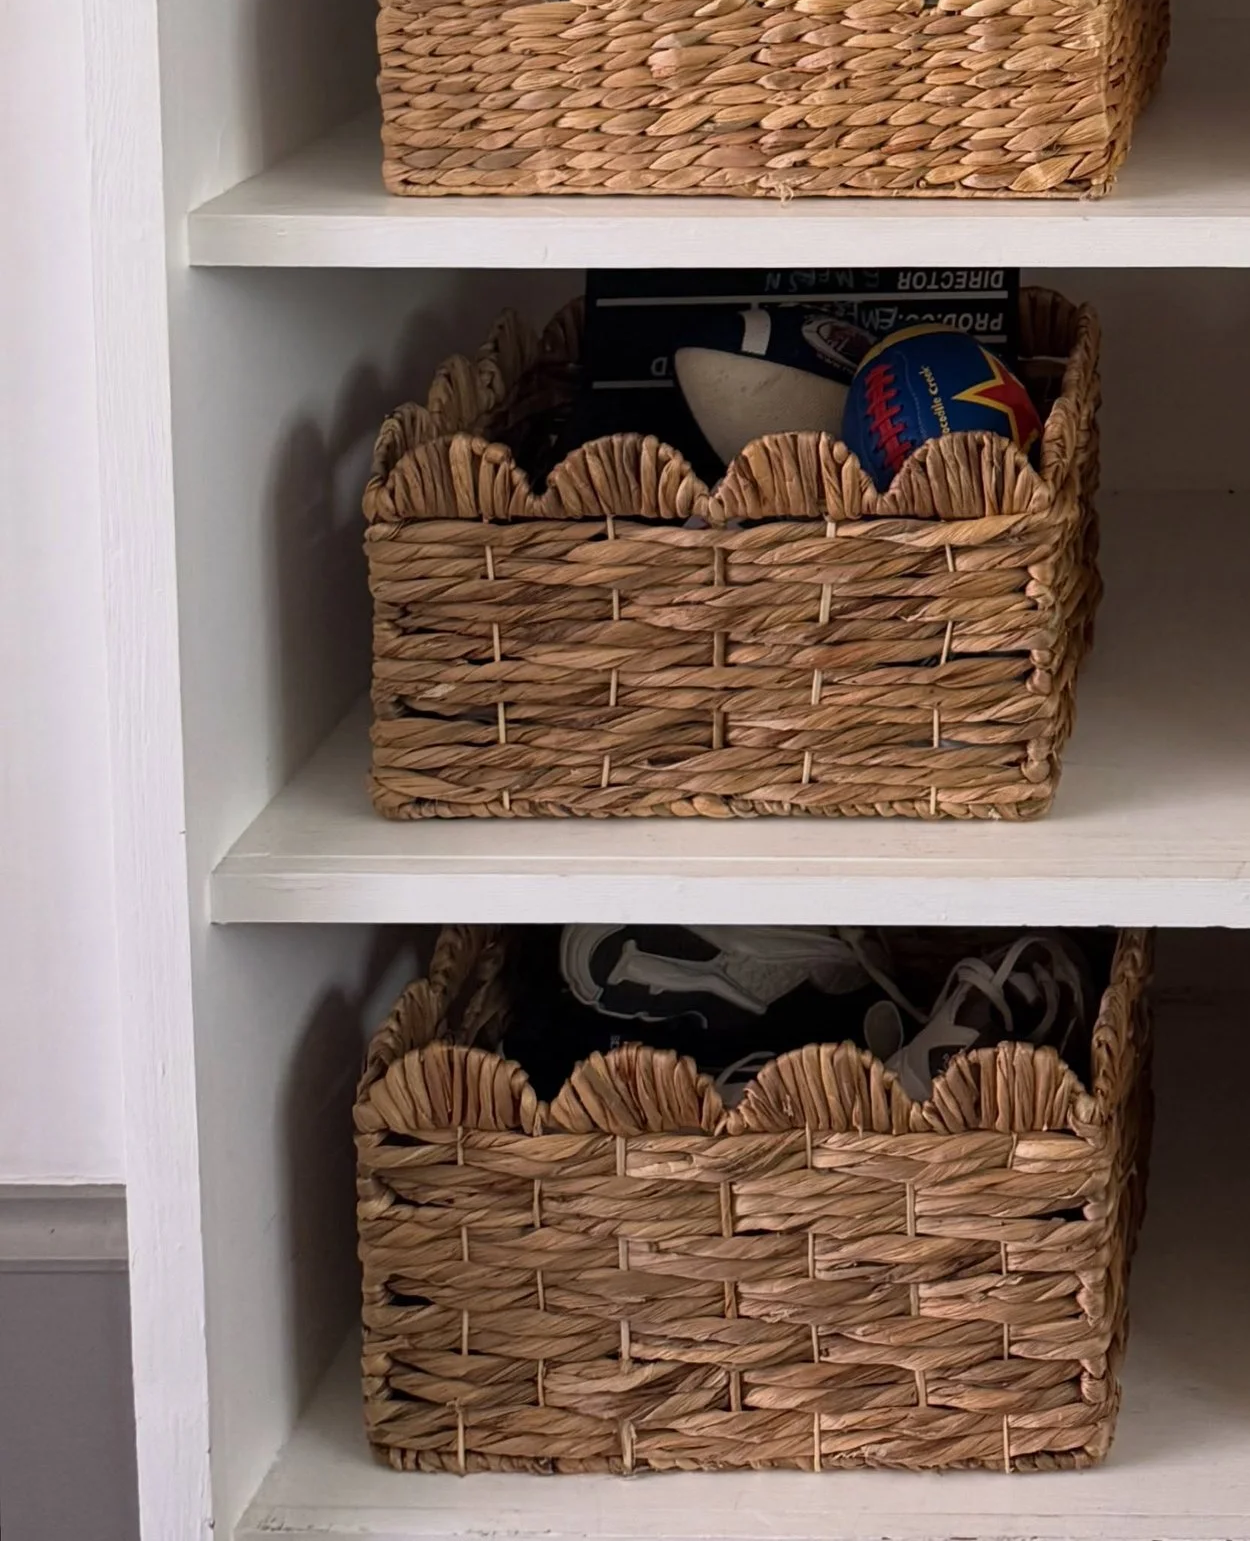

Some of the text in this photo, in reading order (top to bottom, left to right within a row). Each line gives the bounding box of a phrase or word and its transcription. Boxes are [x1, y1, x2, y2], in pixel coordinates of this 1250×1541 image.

[898, 270, 1004, 291] DIRECTOR
[919, 364, 950, 434] ocodile Creek
